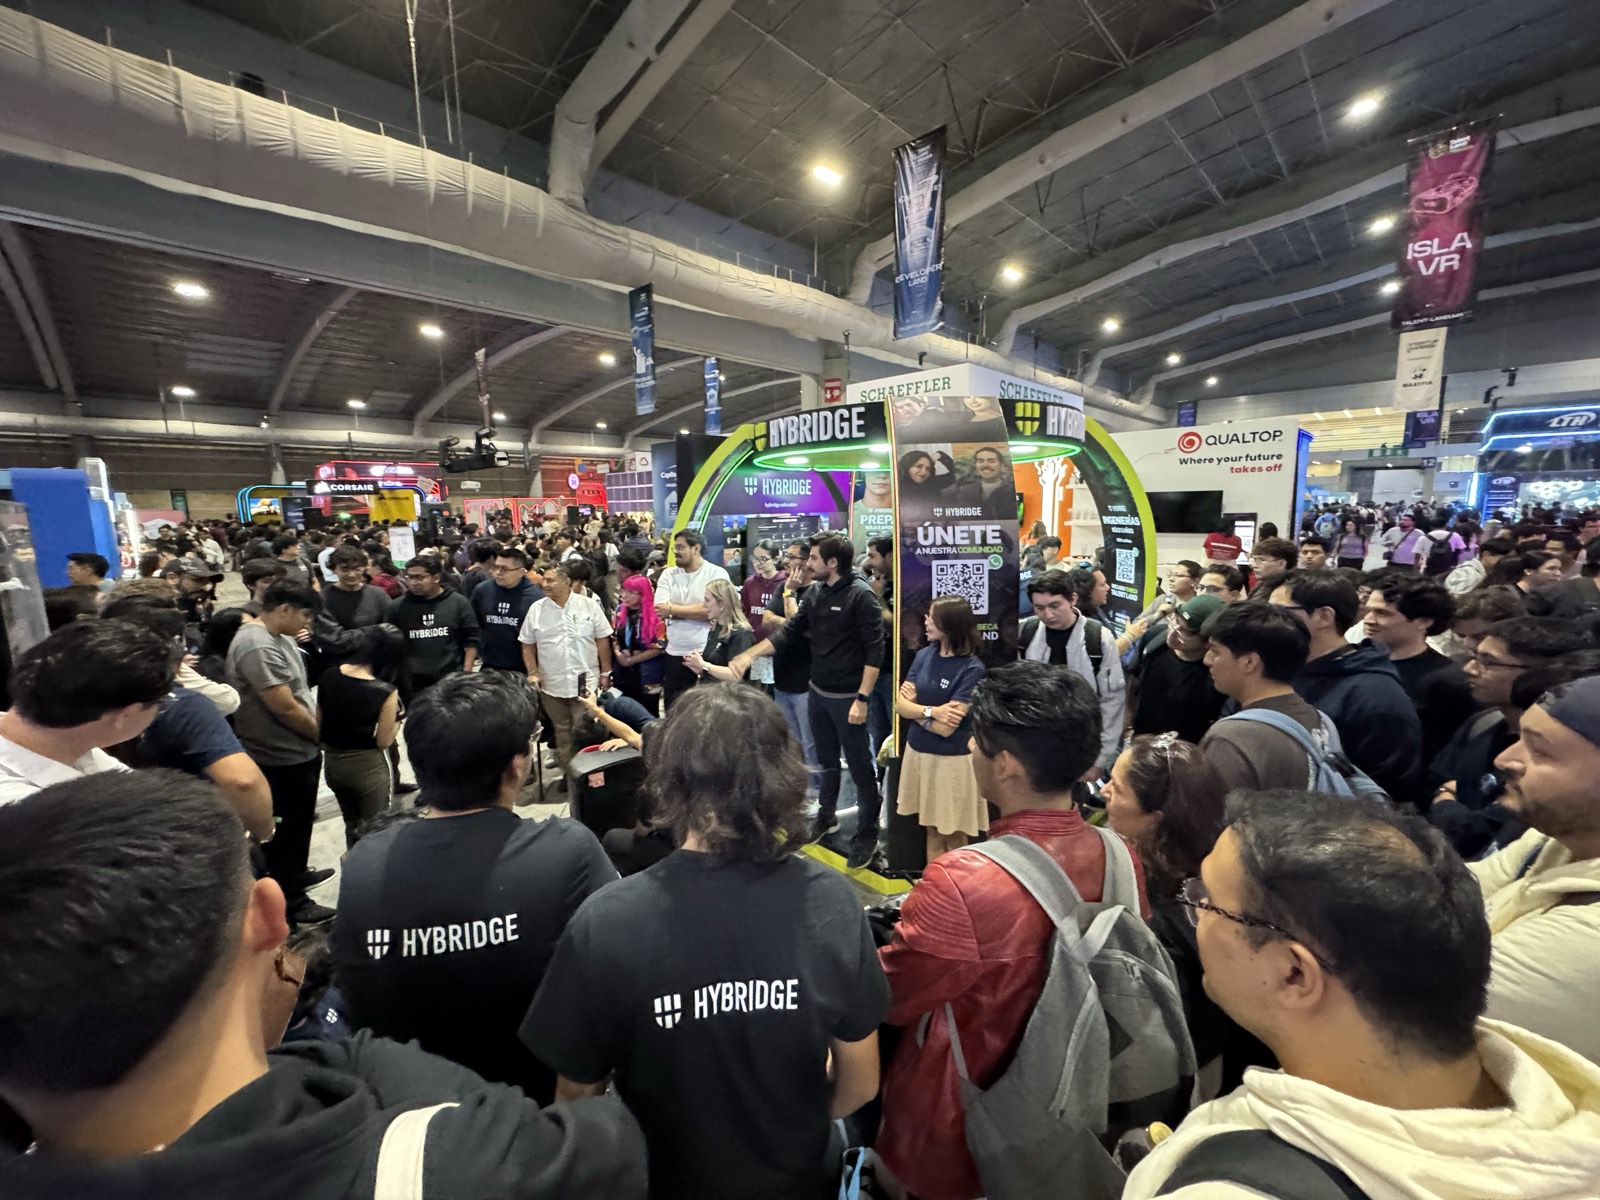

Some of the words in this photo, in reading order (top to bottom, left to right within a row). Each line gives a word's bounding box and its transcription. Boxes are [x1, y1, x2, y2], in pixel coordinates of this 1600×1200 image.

[1407, 232, 1472, 261] ISLA
[1417, 253, 1461, 276] VR
[895, 263, 943, 284] DEVELOPER
[908, 276, 928, 287] LAND
[860, 376, 952, 403] SCHAEFFLER
[769, 406, 866, 448] HYBRIDGE
[1205, 430, 1283, 446] QUALTOP
[1179, 457, 1214, 466] Where
[1216, 456, 1243, 468] your
[1245, 452, 1283, 462] future
[1422, 459, 1435, 467] 12
[1230, 464, 1263, 474] takes
[1266, 463, 1282, 473] off
[762, 478, 812, 495] HYBRIDGE
[860, 514, 893, 525] PREP
[945, 507, 982, 517] HYBRIDGE
[916, 522, 1001, 547] ÚNETE
[923, 547, 958, 555] NUESTRA
[958, 546, 1003, 555] COMUNIDAD
[486, 615, 519, 627] HYBRIDGE
[976, 623, 999, 631] BECA
[409, 626, 449, 639] HYBRIDGE
[402, 913, 519, 958] HYBRIDGE
[693, 978, 799, 1019] HYBRIDGE
